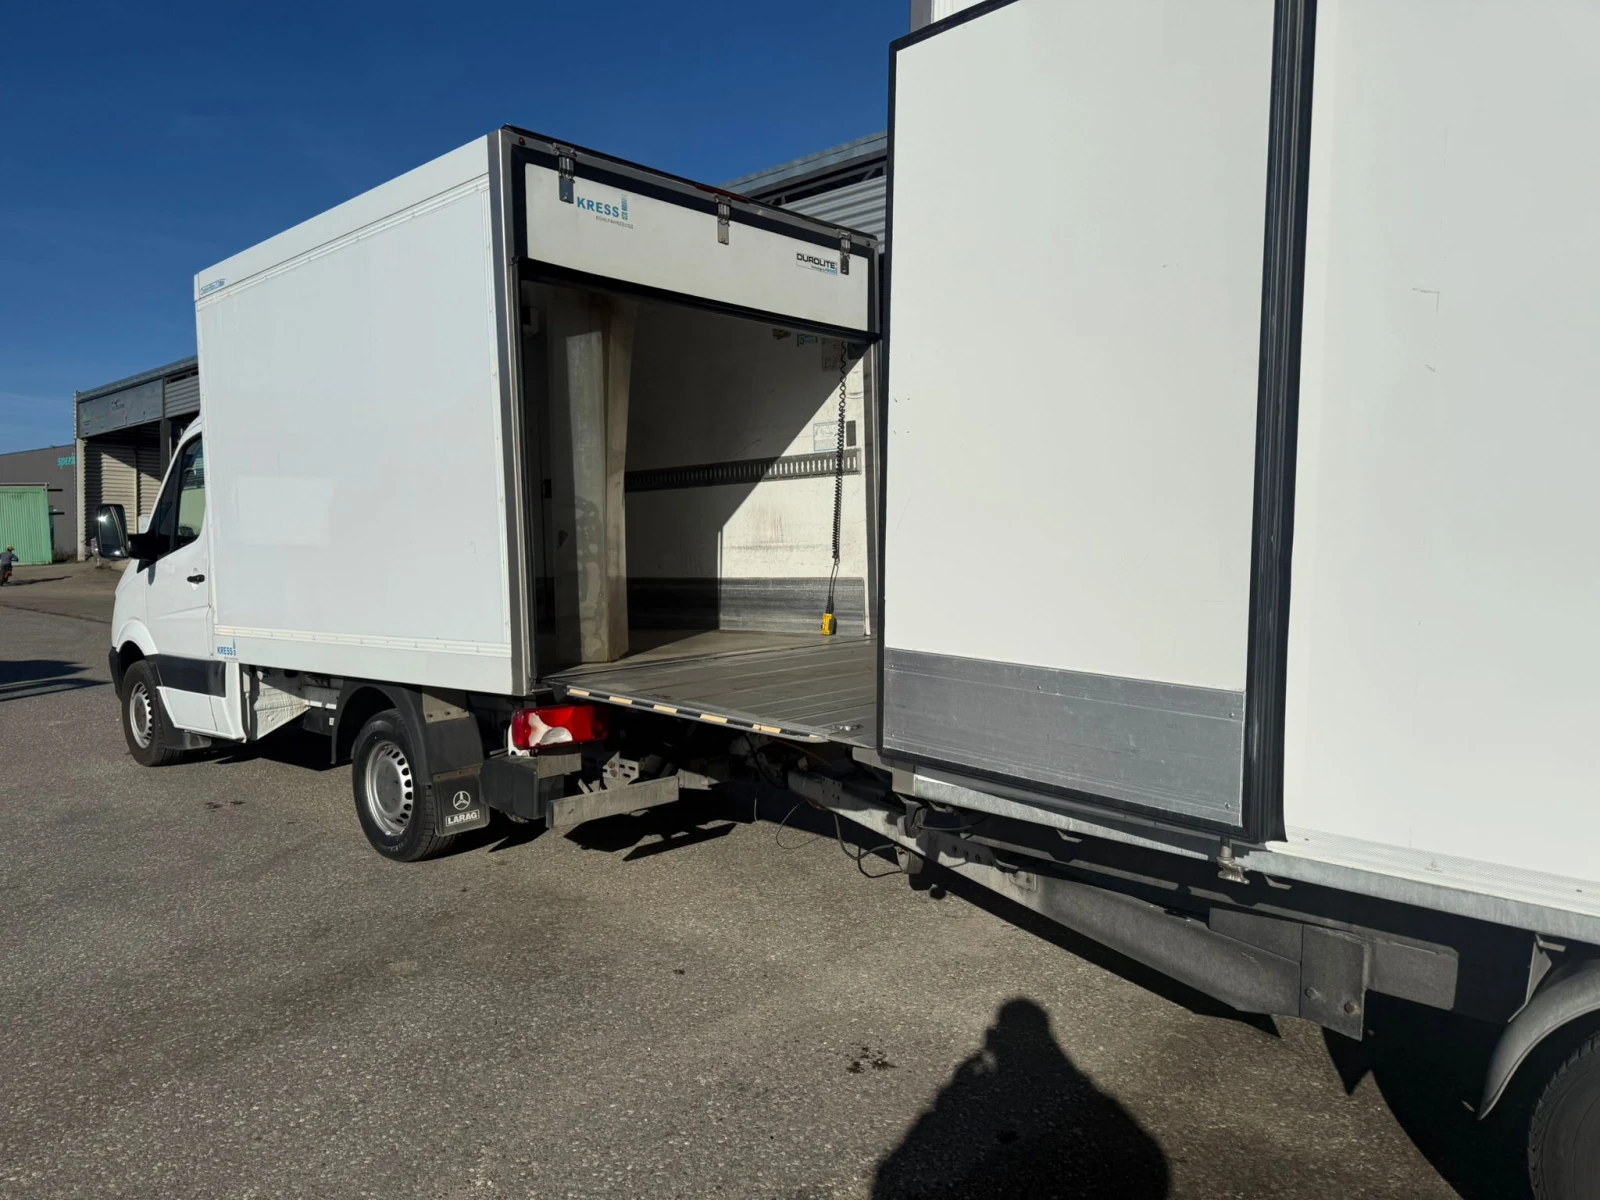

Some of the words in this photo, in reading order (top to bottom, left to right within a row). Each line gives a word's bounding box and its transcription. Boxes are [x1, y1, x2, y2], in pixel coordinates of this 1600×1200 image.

[577, 196, 620, 218] KRESS
[796, 253, 836, 269] DUROLITE
[217, 646, 233, 656] KRESS
[447, 811, 478, 825] LARAG
